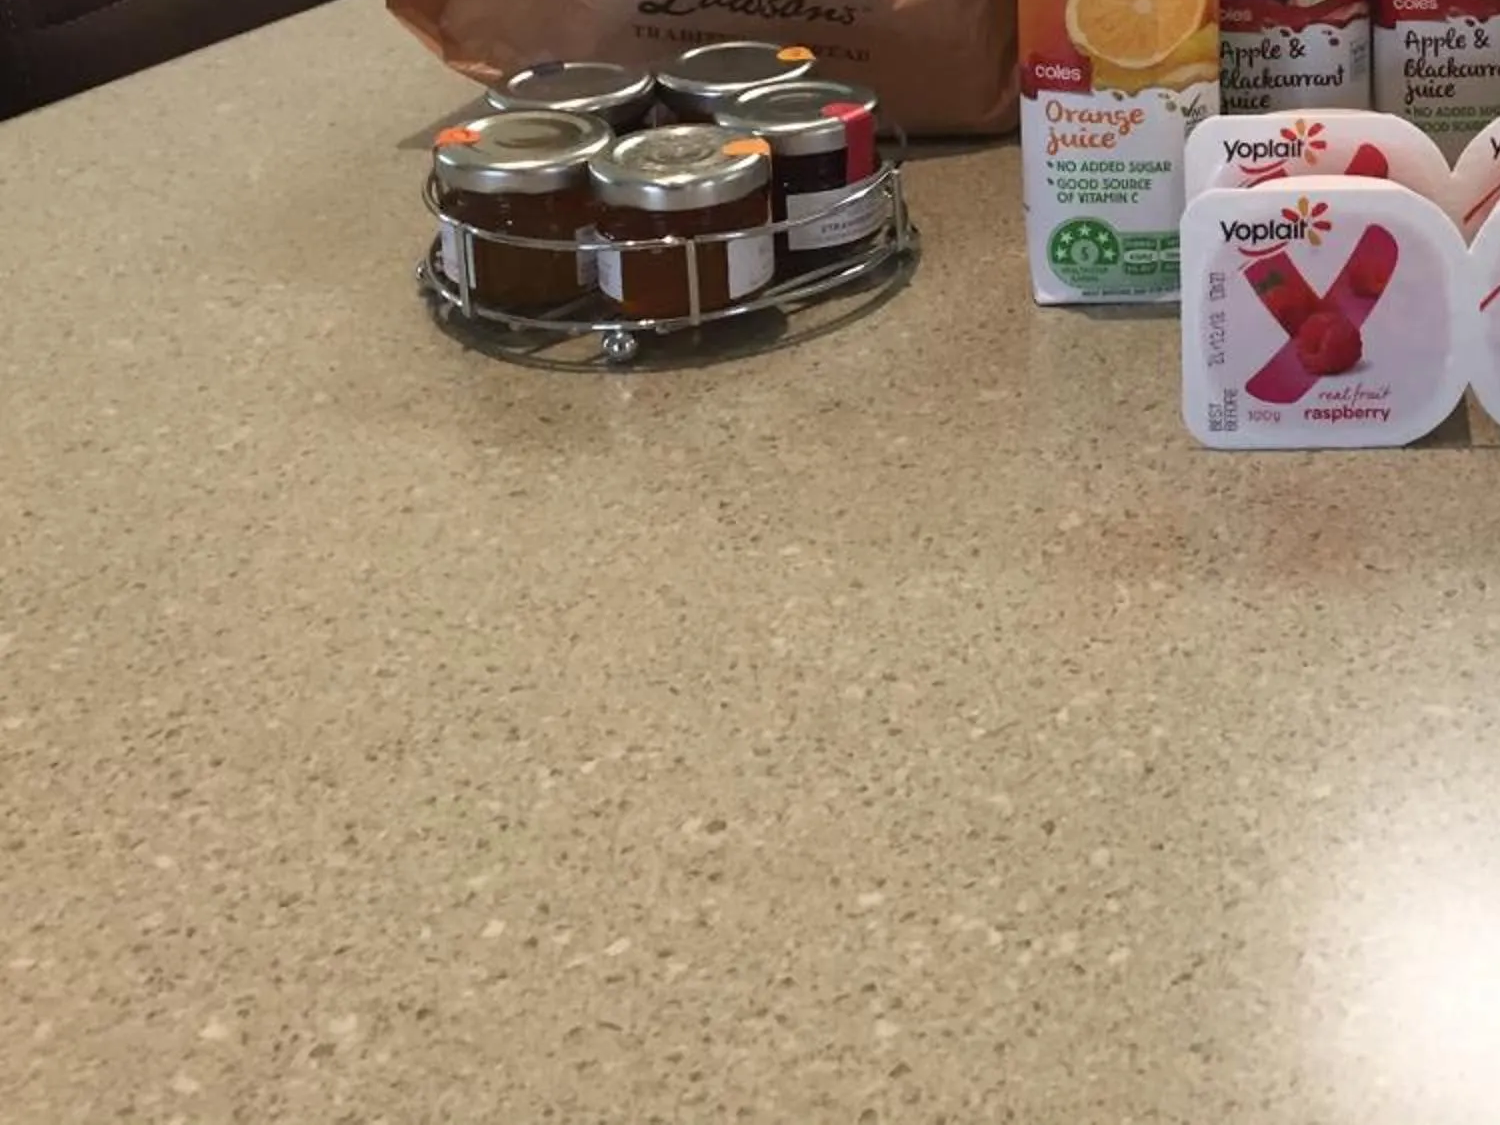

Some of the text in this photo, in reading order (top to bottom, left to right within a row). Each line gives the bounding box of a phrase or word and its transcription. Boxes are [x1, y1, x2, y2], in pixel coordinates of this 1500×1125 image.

[1220, 7, 1254, 21] oles
[1220, 37, 1306, 68] Apple &
[1404, 27, 1490, 58] Apple &
[1034, 63, 1082, 82] coles
[1219, 64, 1344, 91] Blackcurrant
[1404, 79, 1457, 105] juice
[1219, 91, 1272, 116] juice
[1045, 99, 1146, 136] Orange
[1046, 126, 1117, 156] juice
[1056, 160, 1173, 174] NO ADDED SUGAR
[1057, 177, 1153, 191] GOOD SOURCE
[1056, 191, 1139, 204] OF VITAMIN C
[1248, 409, 1281, 423] 100g
[1303, 405, 1391, 425] raspberry
